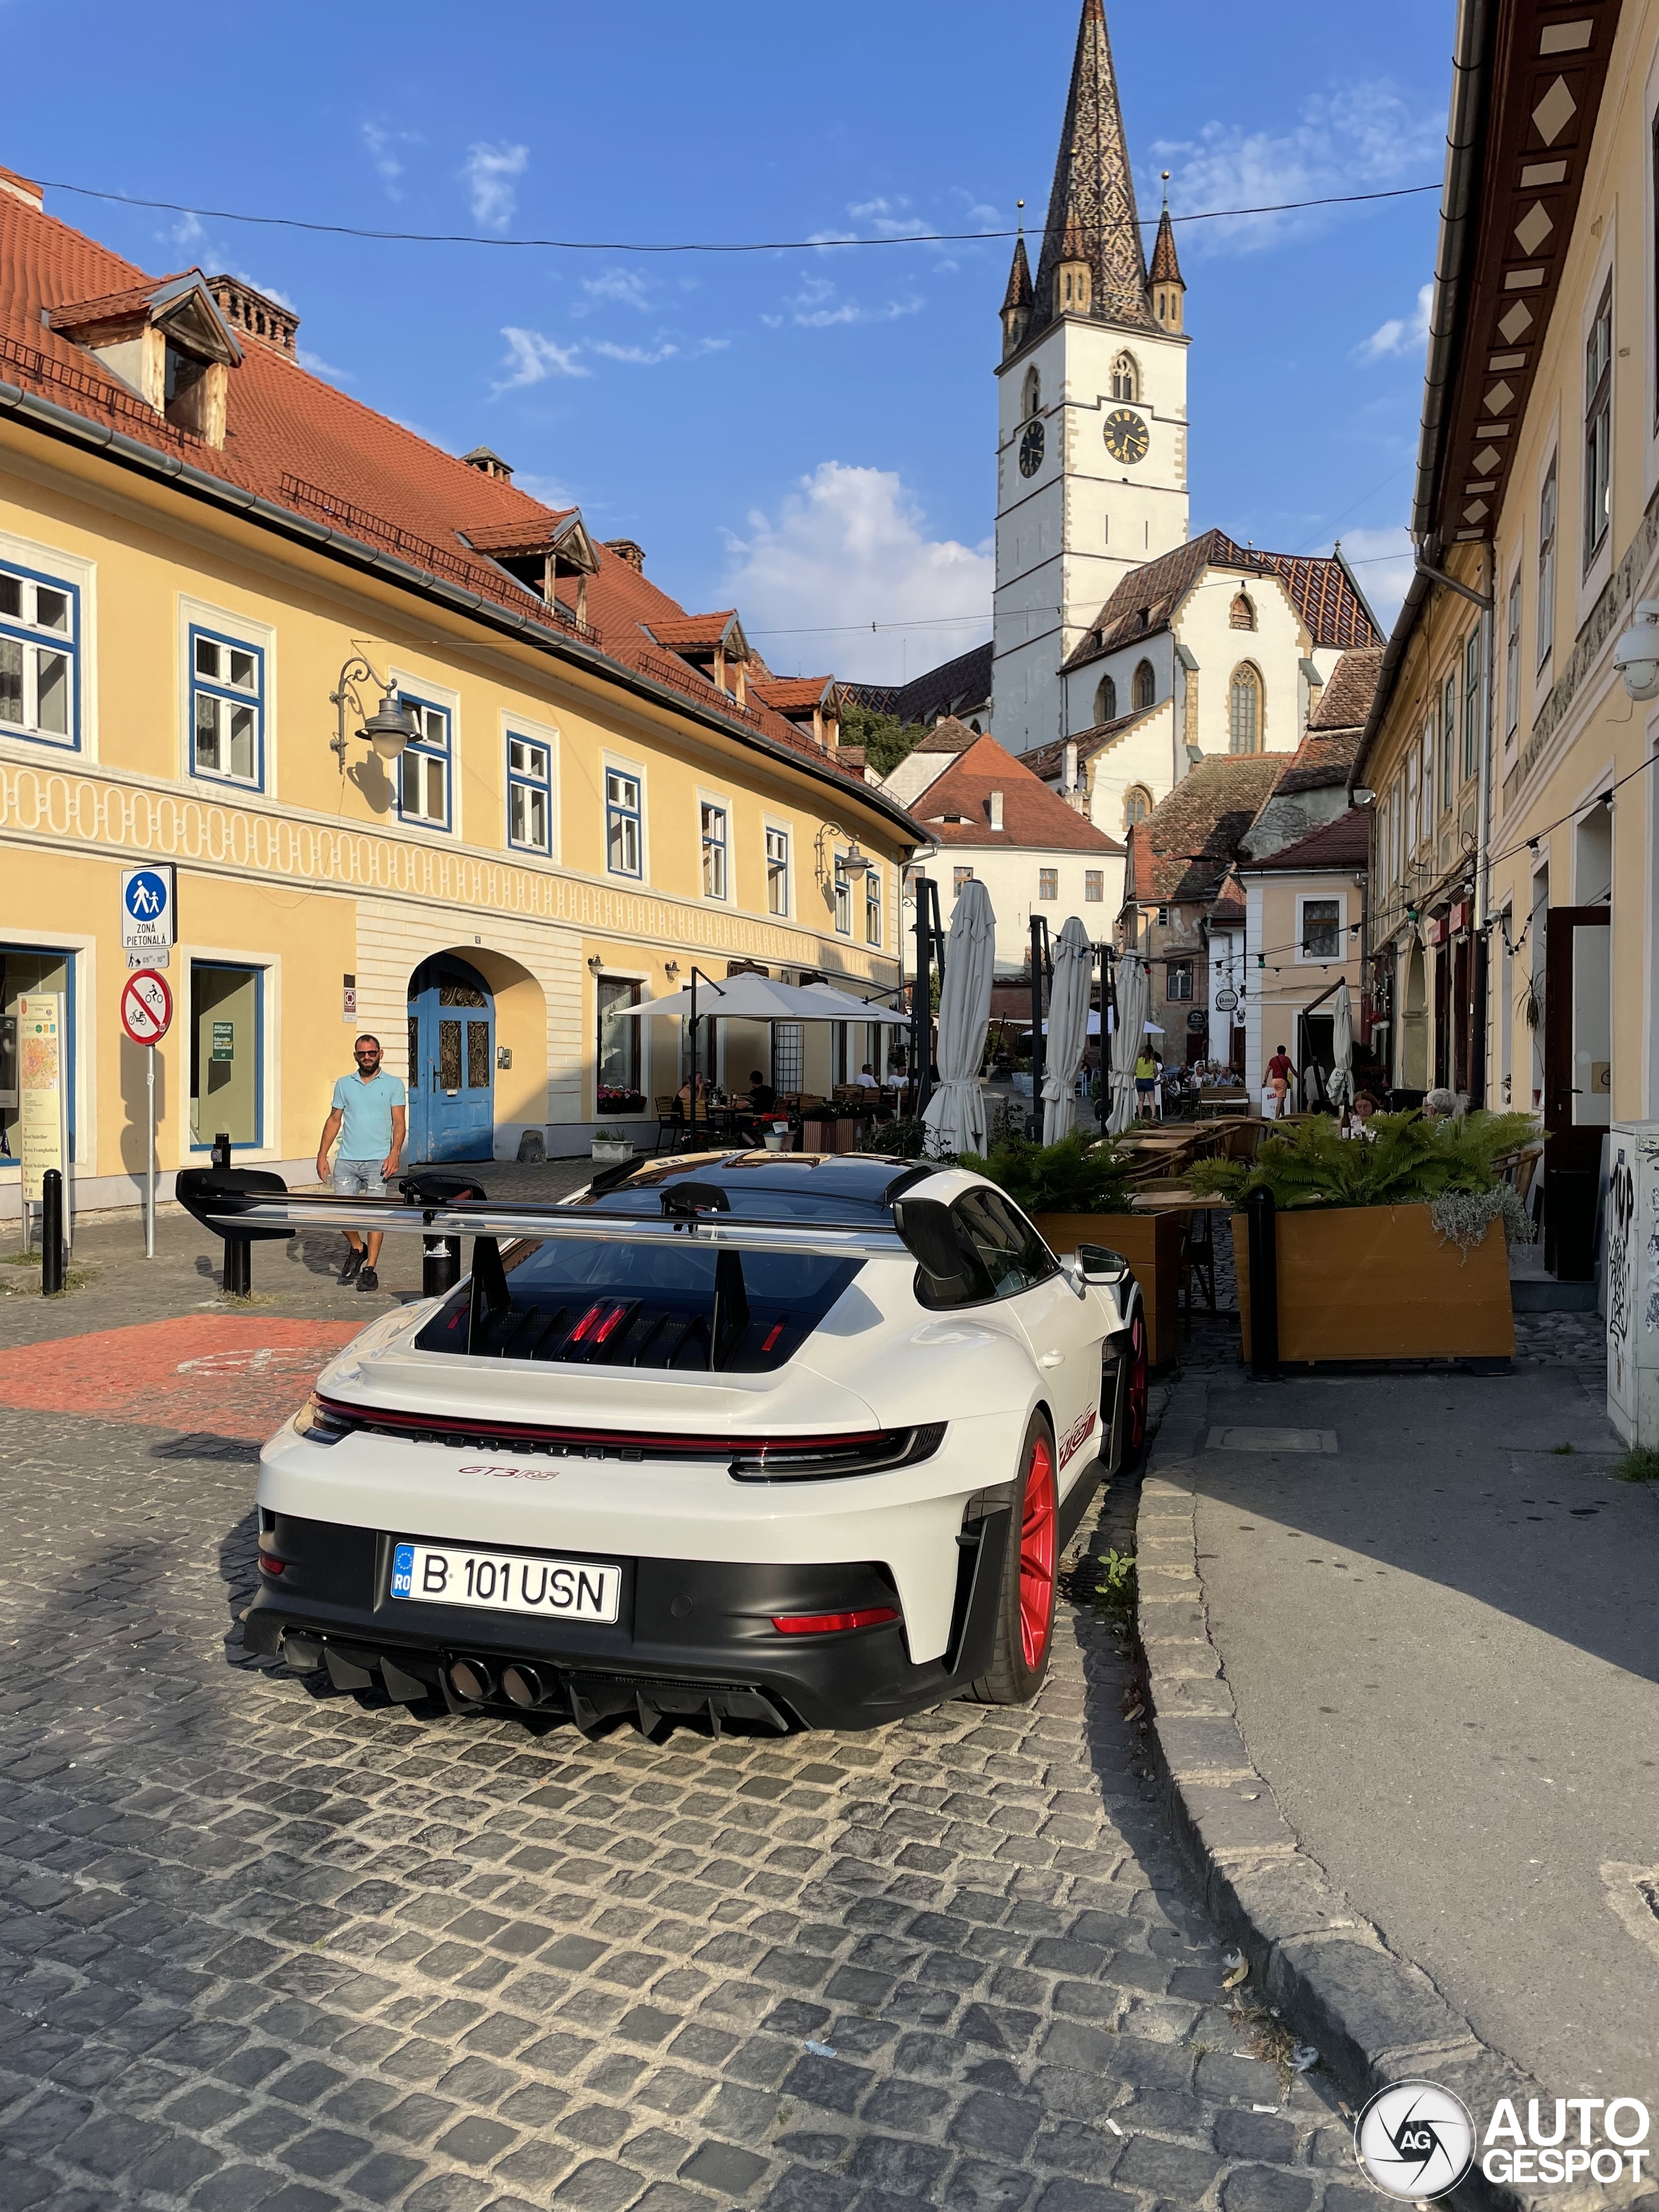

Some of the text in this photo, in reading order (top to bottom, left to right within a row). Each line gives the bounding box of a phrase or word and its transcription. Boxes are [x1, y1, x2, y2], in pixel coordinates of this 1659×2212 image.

[137, 922, 156, 934] ZONĂ
[127, 933, 167, 946] PIETONALĂ
[395, 1573, 411, 1592] RO
[422, 1554, 449, 1594] B
